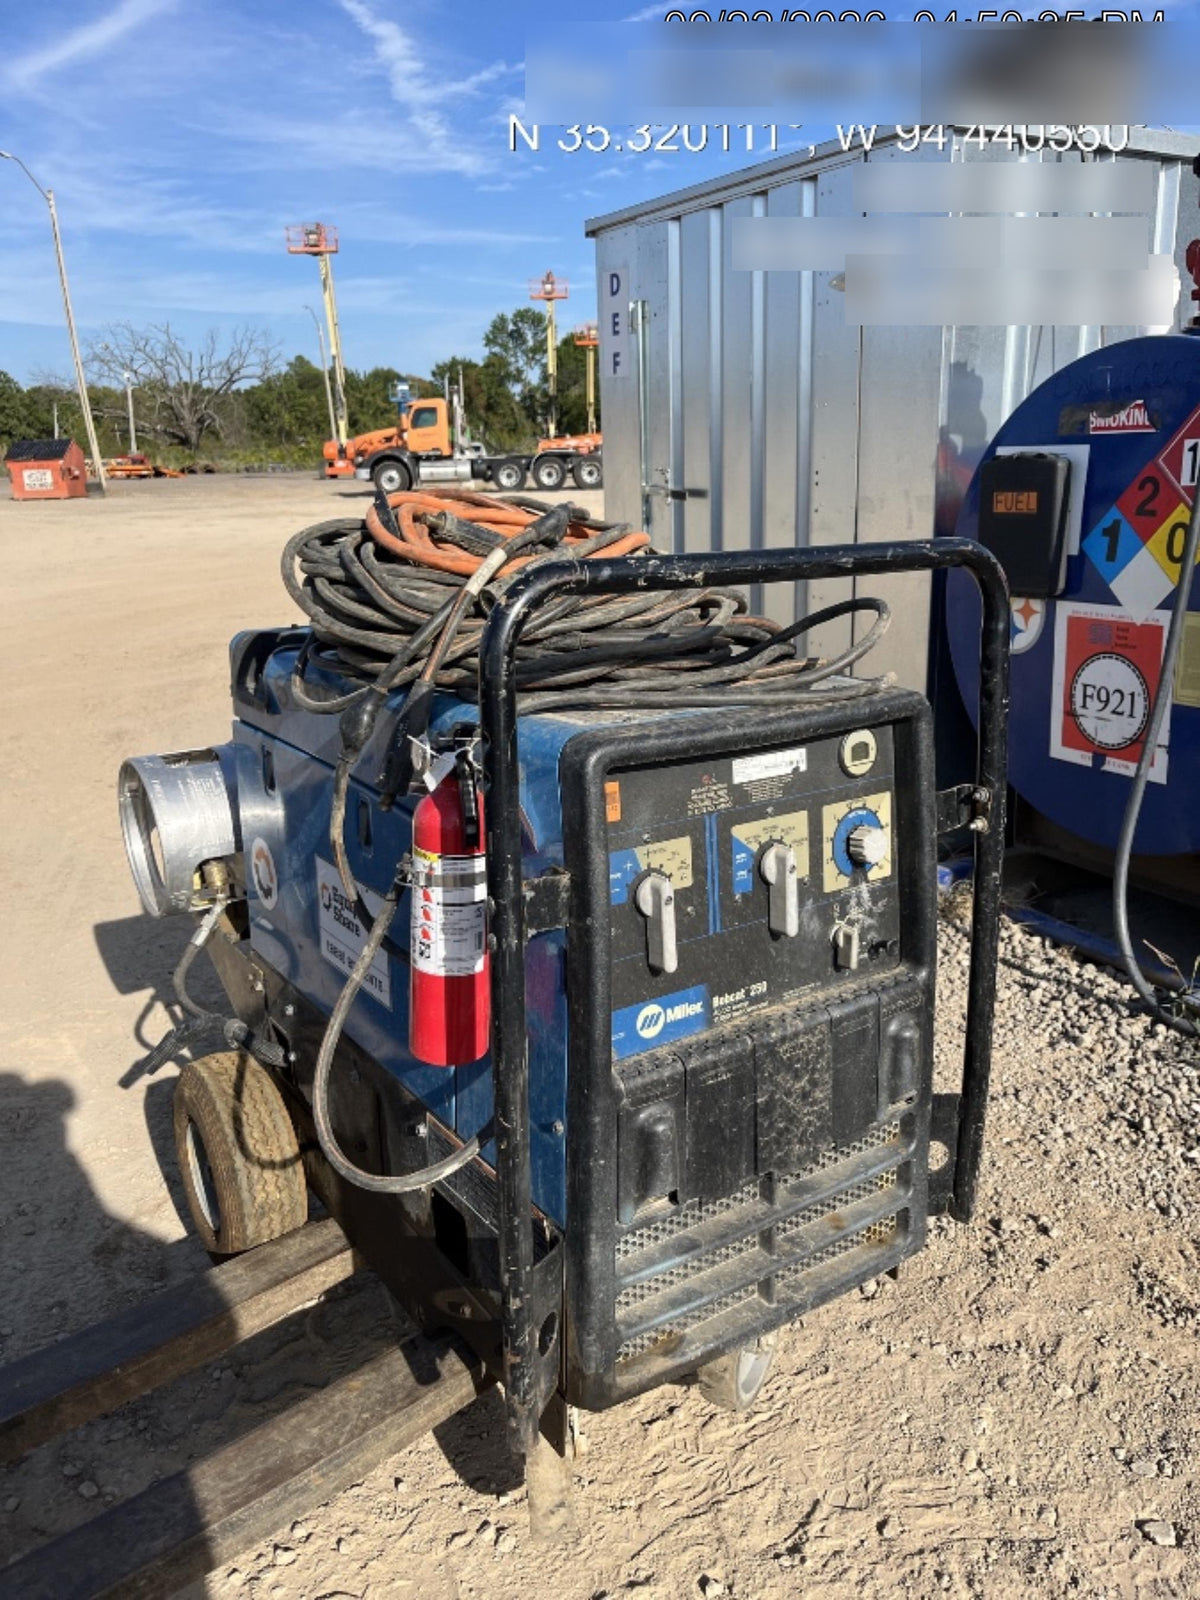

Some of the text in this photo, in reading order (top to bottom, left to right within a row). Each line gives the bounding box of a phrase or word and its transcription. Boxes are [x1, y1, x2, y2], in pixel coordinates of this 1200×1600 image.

[995, 493, 1036, 511] FUEL
[1135, 476, 1160, 517] 2
[1102, 519, 1122, 562] 1
[1166, 522, 1189, 565] 0
[1079, 682, 1137, 719] F921
[666, 1001, 703, 1023] Miller
